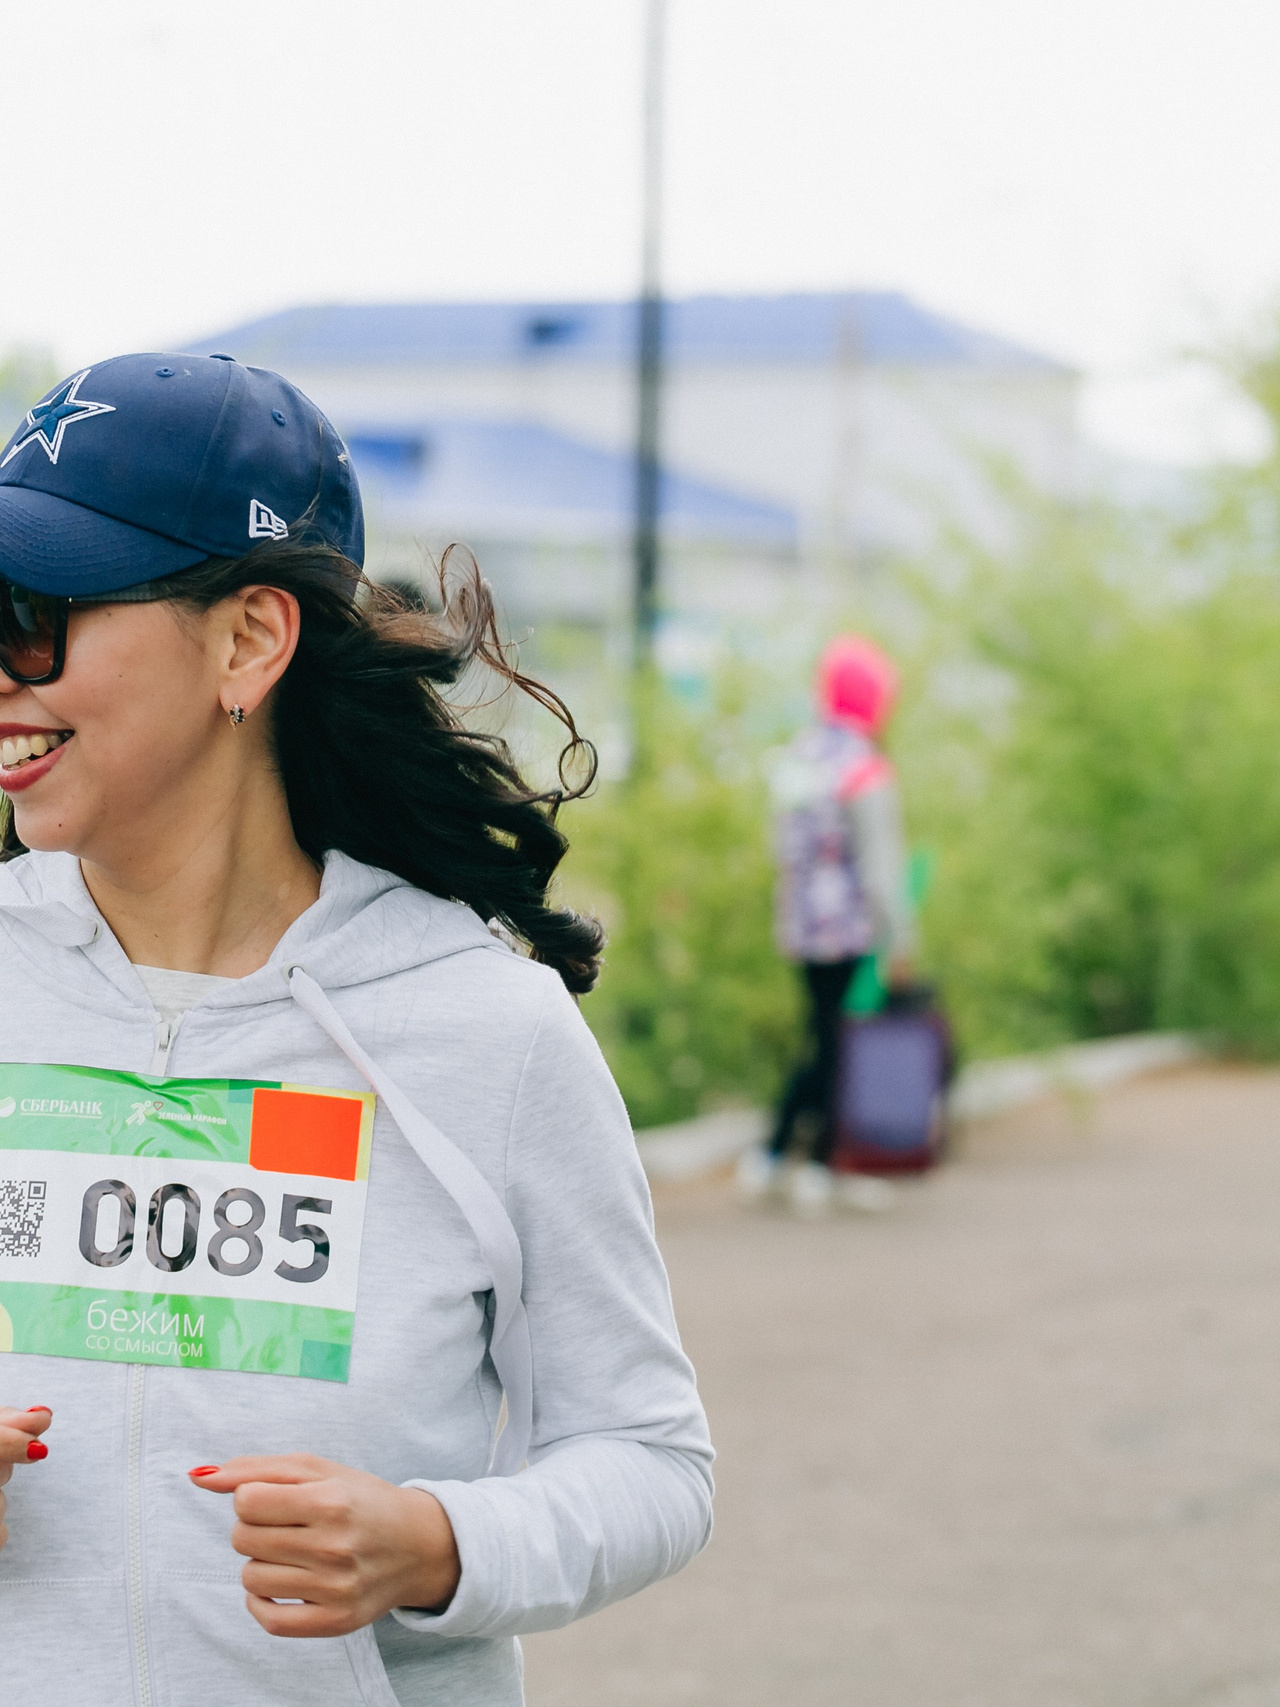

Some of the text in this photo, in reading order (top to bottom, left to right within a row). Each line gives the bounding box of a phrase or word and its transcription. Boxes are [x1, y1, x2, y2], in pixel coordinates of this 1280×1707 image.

[20, 1098, 103, 1115] СБЕРБАНК
[78, 1178, 333, 1283] 0085
[87, 1299, 205, 1338] бежим
